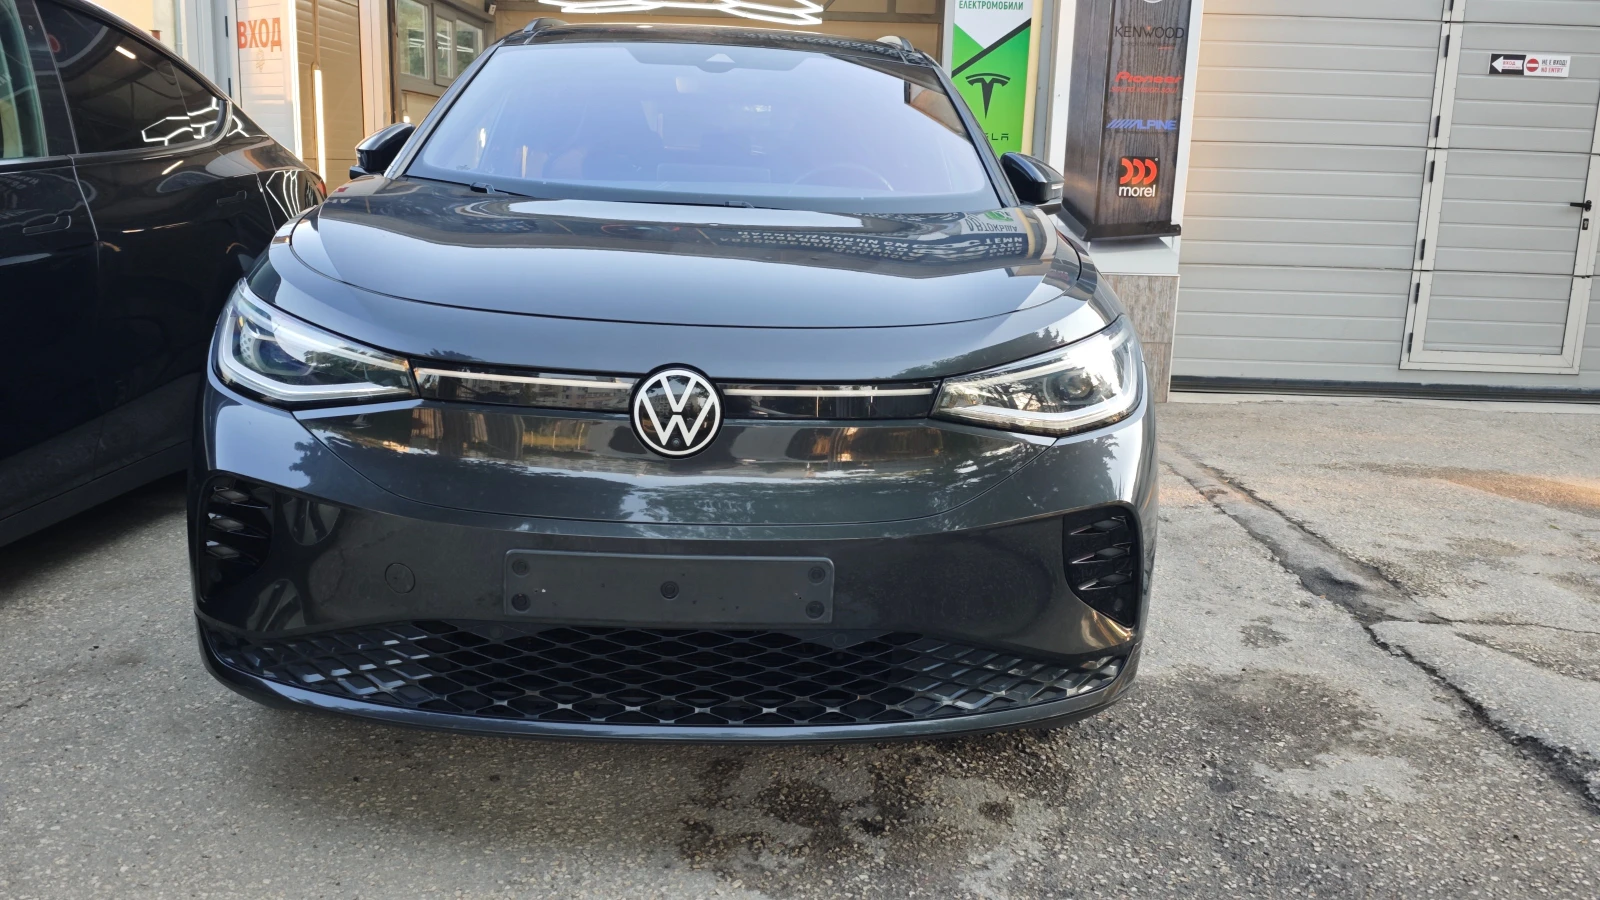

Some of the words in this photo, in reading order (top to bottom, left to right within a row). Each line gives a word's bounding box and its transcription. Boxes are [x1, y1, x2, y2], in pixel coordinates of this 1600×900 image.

[959, 1, 1024, 10] ЕЛЕКТРОМОБИЛИ
[237, 17, 282, 52] ВХОД
[1114, 26, 1185, 38] KENWOOD
[1115, 71, 1182, 83] Pioneer
[1128, 119, 1177, 130] ALPINE
[1118, 184, 1156, 197] morel
